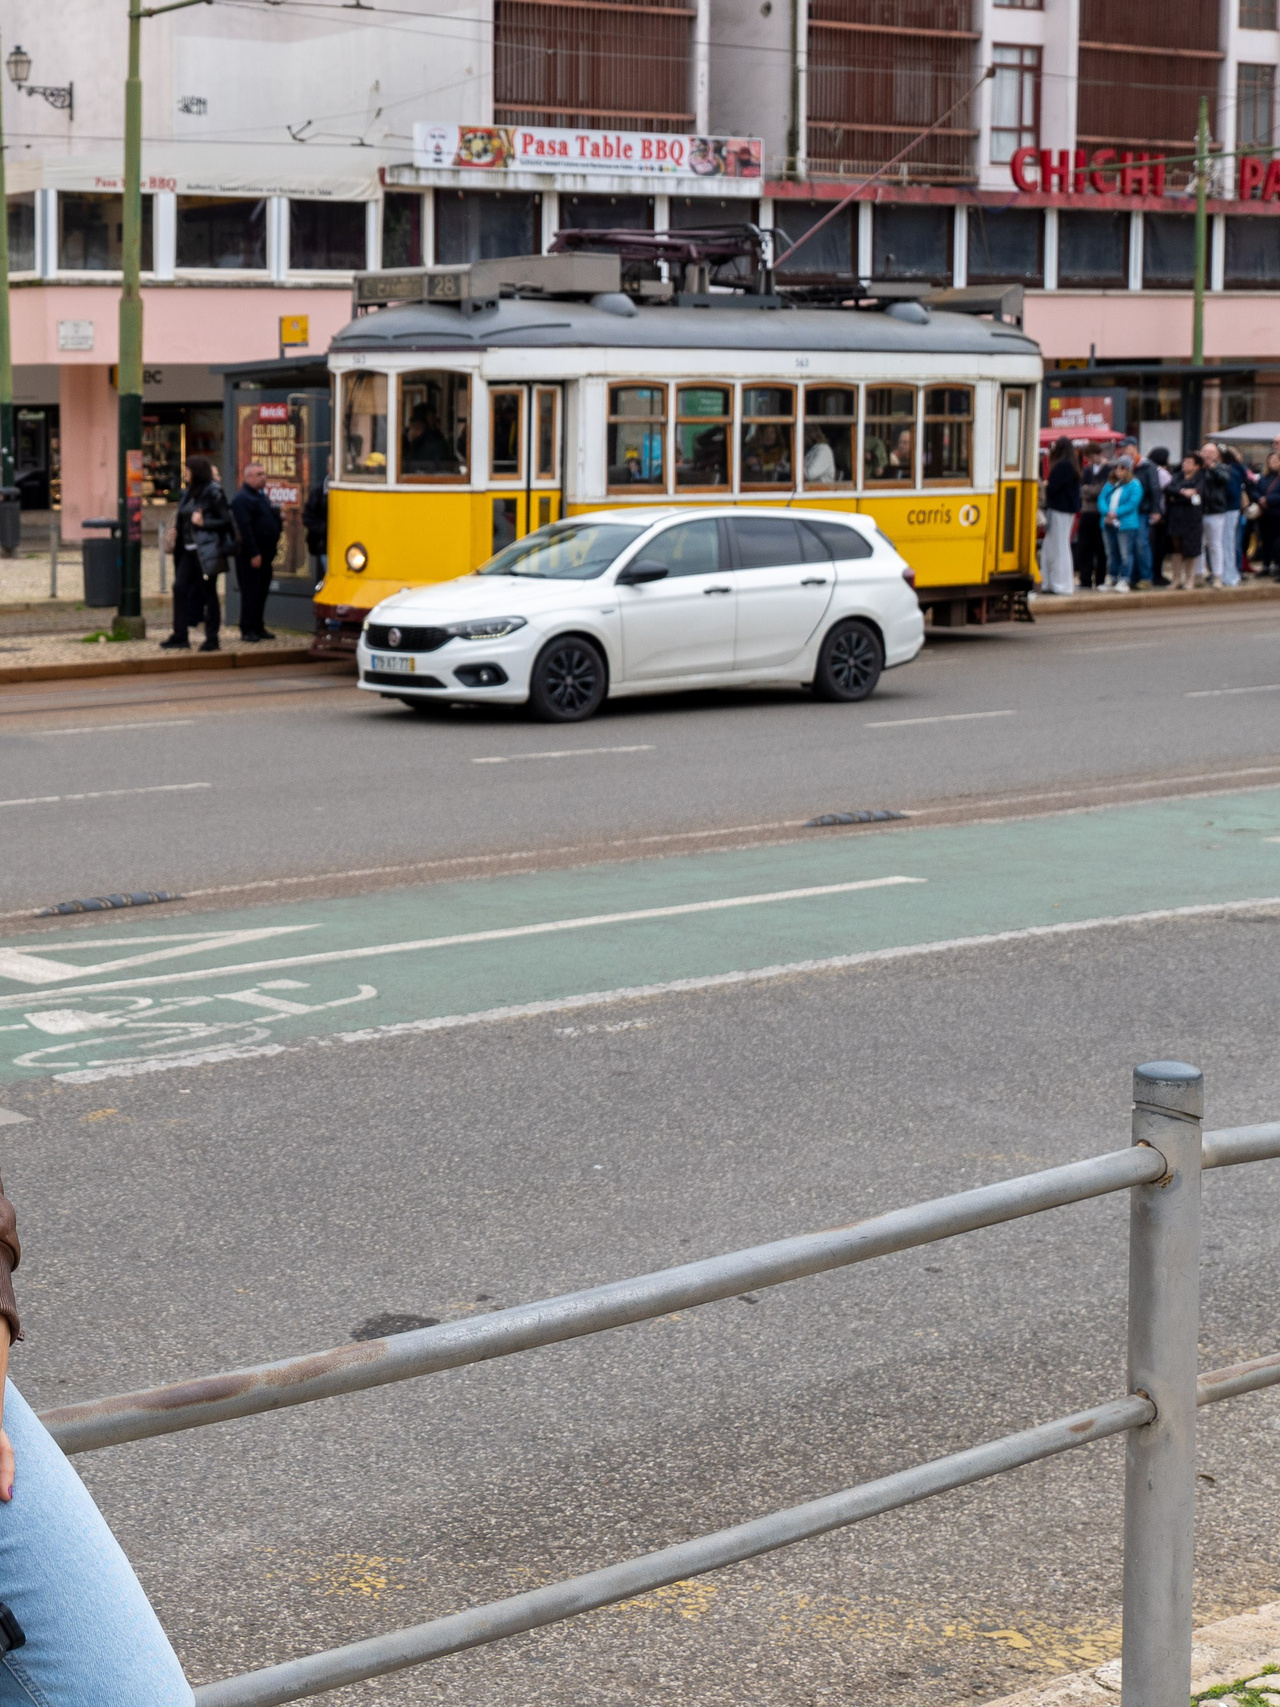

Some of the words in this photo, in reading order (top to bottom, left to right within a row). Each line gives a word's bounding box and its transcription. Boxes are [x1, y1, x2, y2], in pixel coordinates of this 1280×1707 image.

[521, 132, 569, 157] Pasa
[575, 134, 634, 160] Table
[640, 138, 685, 167] BBQ
[1010, 146, 1166, 197] CHICHI
[149, 176, 177, 191] BBQ
[434, 276, 456, 296] 28
[906, 503, 952, 525] carris
